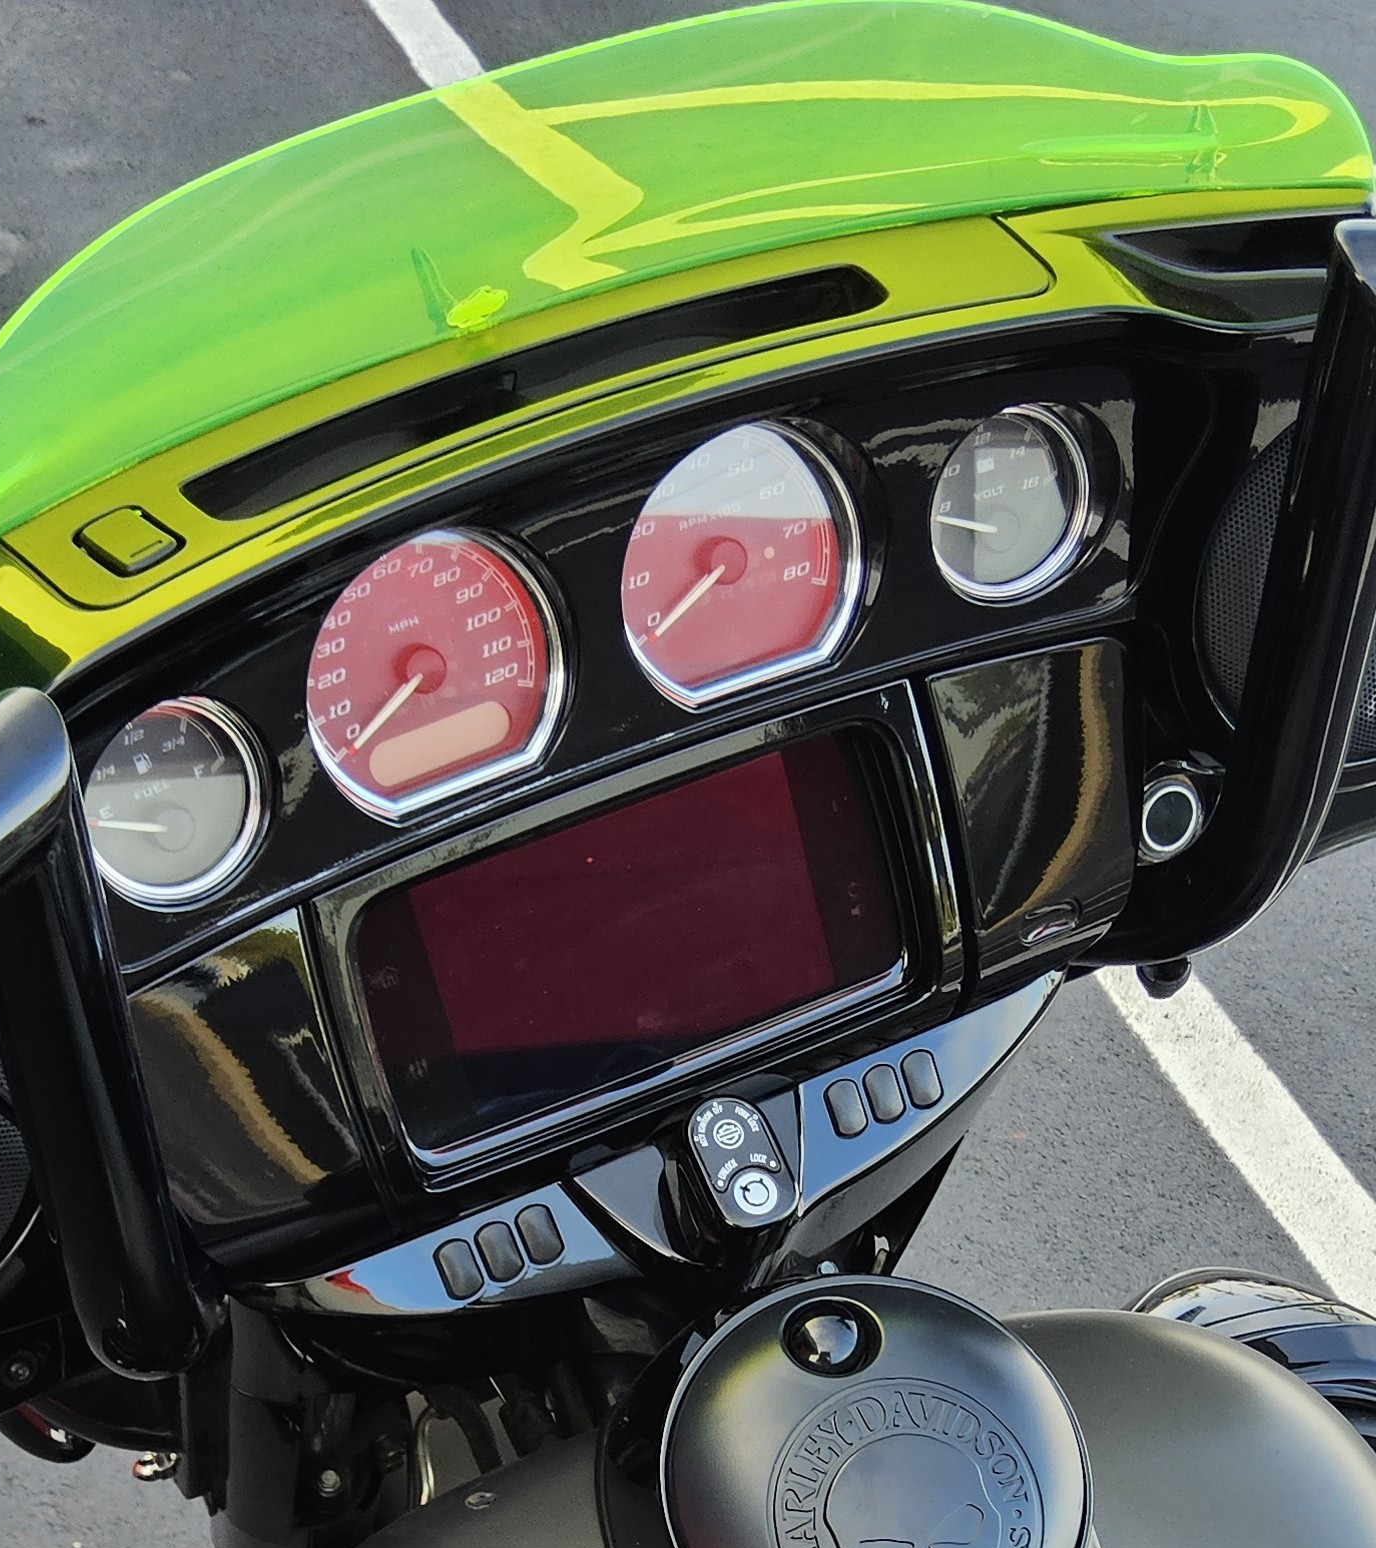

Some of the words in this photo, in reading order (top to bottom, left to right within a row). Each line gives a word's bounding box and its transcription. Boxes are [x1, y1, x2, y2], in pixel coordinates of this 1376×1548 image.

[1009, 445, 1026, 459] 14
[684, 454, 710, 472] 40
[726, 459, 754, 477] 50
[758, 482, 786, 500] 60
[973, 485, 1006, 500] VOLT
[1021, 476, 1040, 490] 16
[939, 501, 951, 514] 8
[783, 521, 807, 540] 70
[373, 559, 401, 580] 60
[407, 559, 433, 578] 70
[433, 567, 461, 588] 80
[783, 562, 810, 581] 80
[628, 572, 650, 590] 10
[343, 582, 371, 604] 50
[455, 583, 483, 604] 90
[323, 611, 351, 630] 40
[388, 616, 419, 634] MPH
[466, 607, 501, 632] 100
[648, 612, 661, 626] 0
[316, 637, 345, 659] 30
[481, 636, 512, 658] 110
[318, 668, 346, 690] 20
[484, 663, 518, 687] 120
[328, 700, 351, 719] 10
[346, 723, 360, 740] 0
[192, 764, 206, 780] F
[133, 779, 173, 800] FUEL
[99, 804, 114, 820] E
[750, 1152, 768, 1164] LOCK
[718, 1158, 738, 1180] UNLOCK
